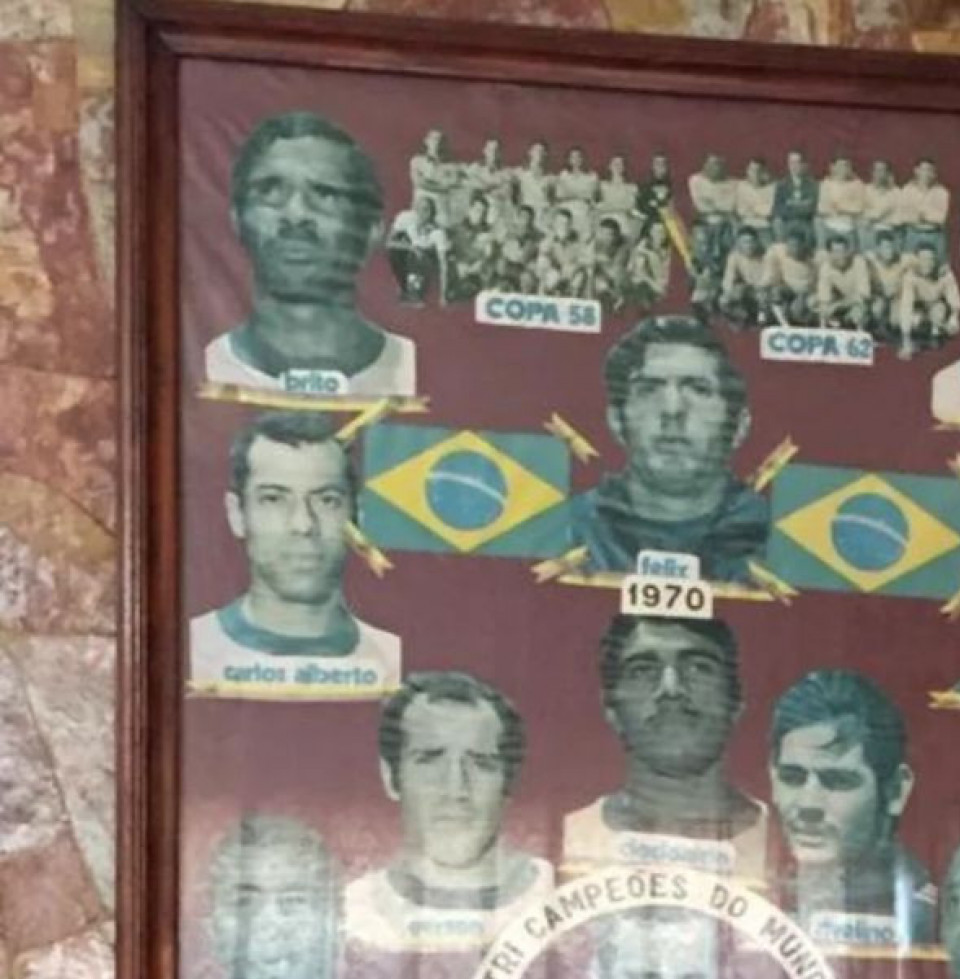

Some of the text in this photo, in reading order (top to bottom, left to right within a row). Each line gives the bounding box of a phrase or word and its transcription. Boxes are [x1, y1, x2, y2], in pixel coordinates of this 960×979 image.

[486, 297, 560, 324] COPA
[768, 331, 872, 358] COPA 62
[284, 370, 339, 393] brito
[629, 582, 705, 612] 1970
[710, 884, 748, 919] DO
